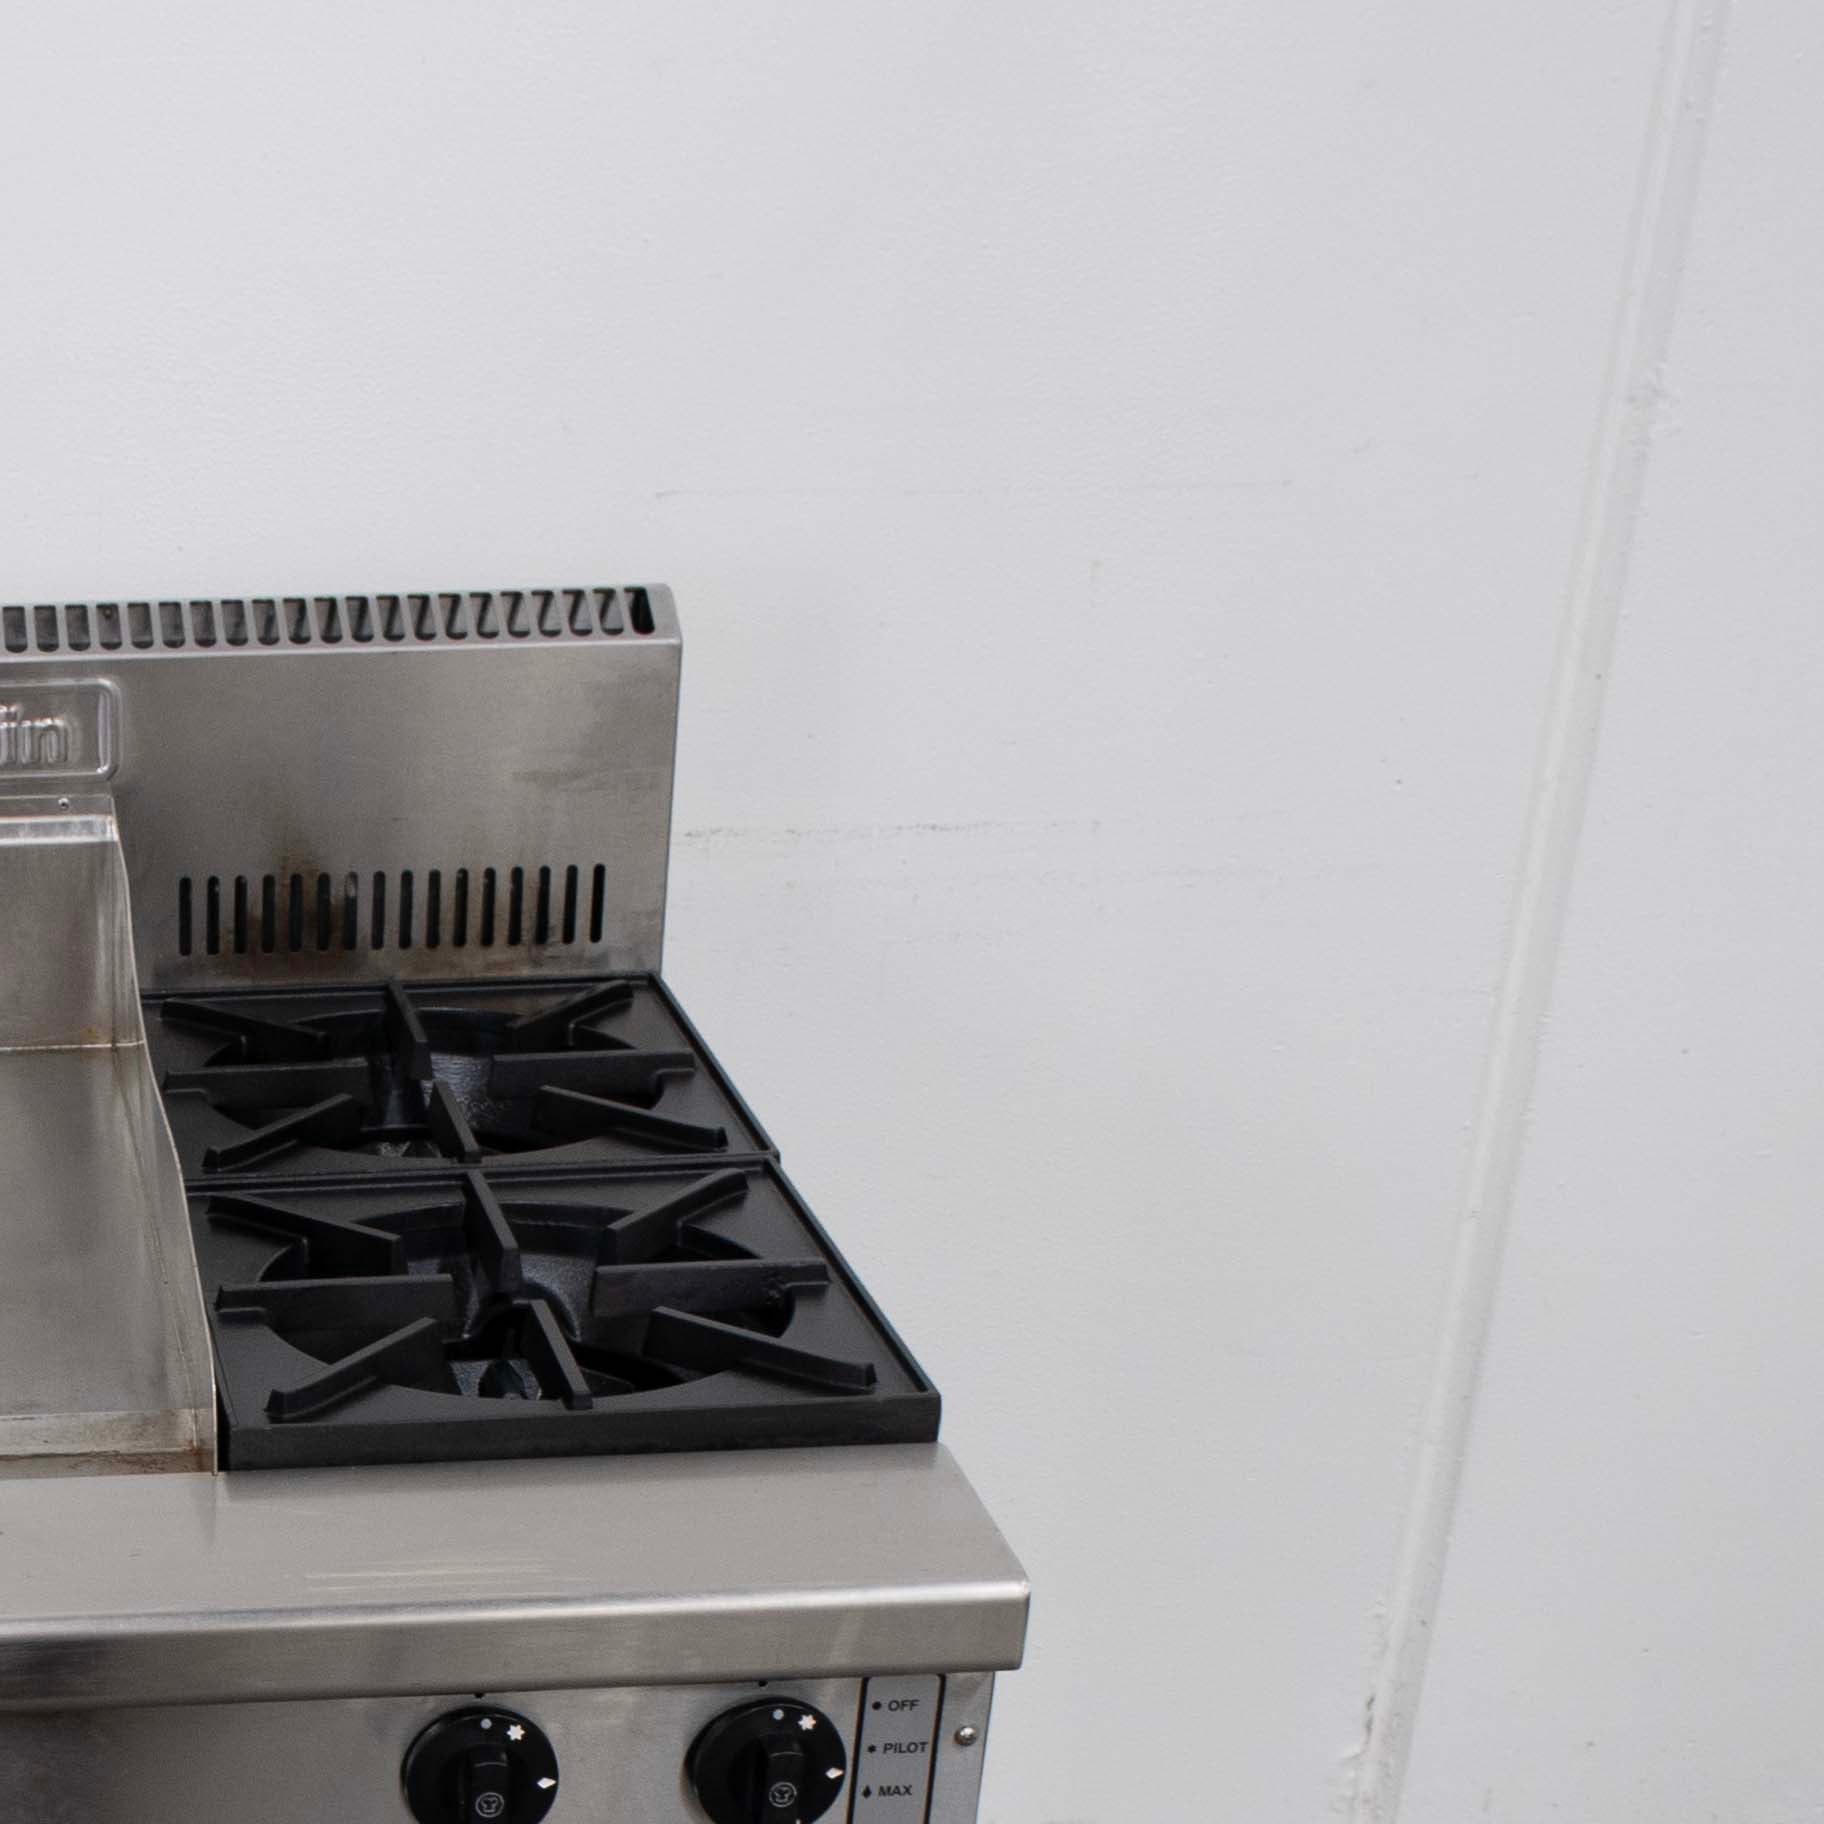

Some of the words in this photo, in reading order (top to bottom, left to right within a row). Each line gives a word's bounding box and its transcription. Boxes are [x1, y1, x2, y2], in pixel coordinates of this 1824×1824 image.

[888, 1700, 920, 1712] OFF
[882, 1742, 929, 1754] PILOT
[878, 1785, 913, 1797] MAX
